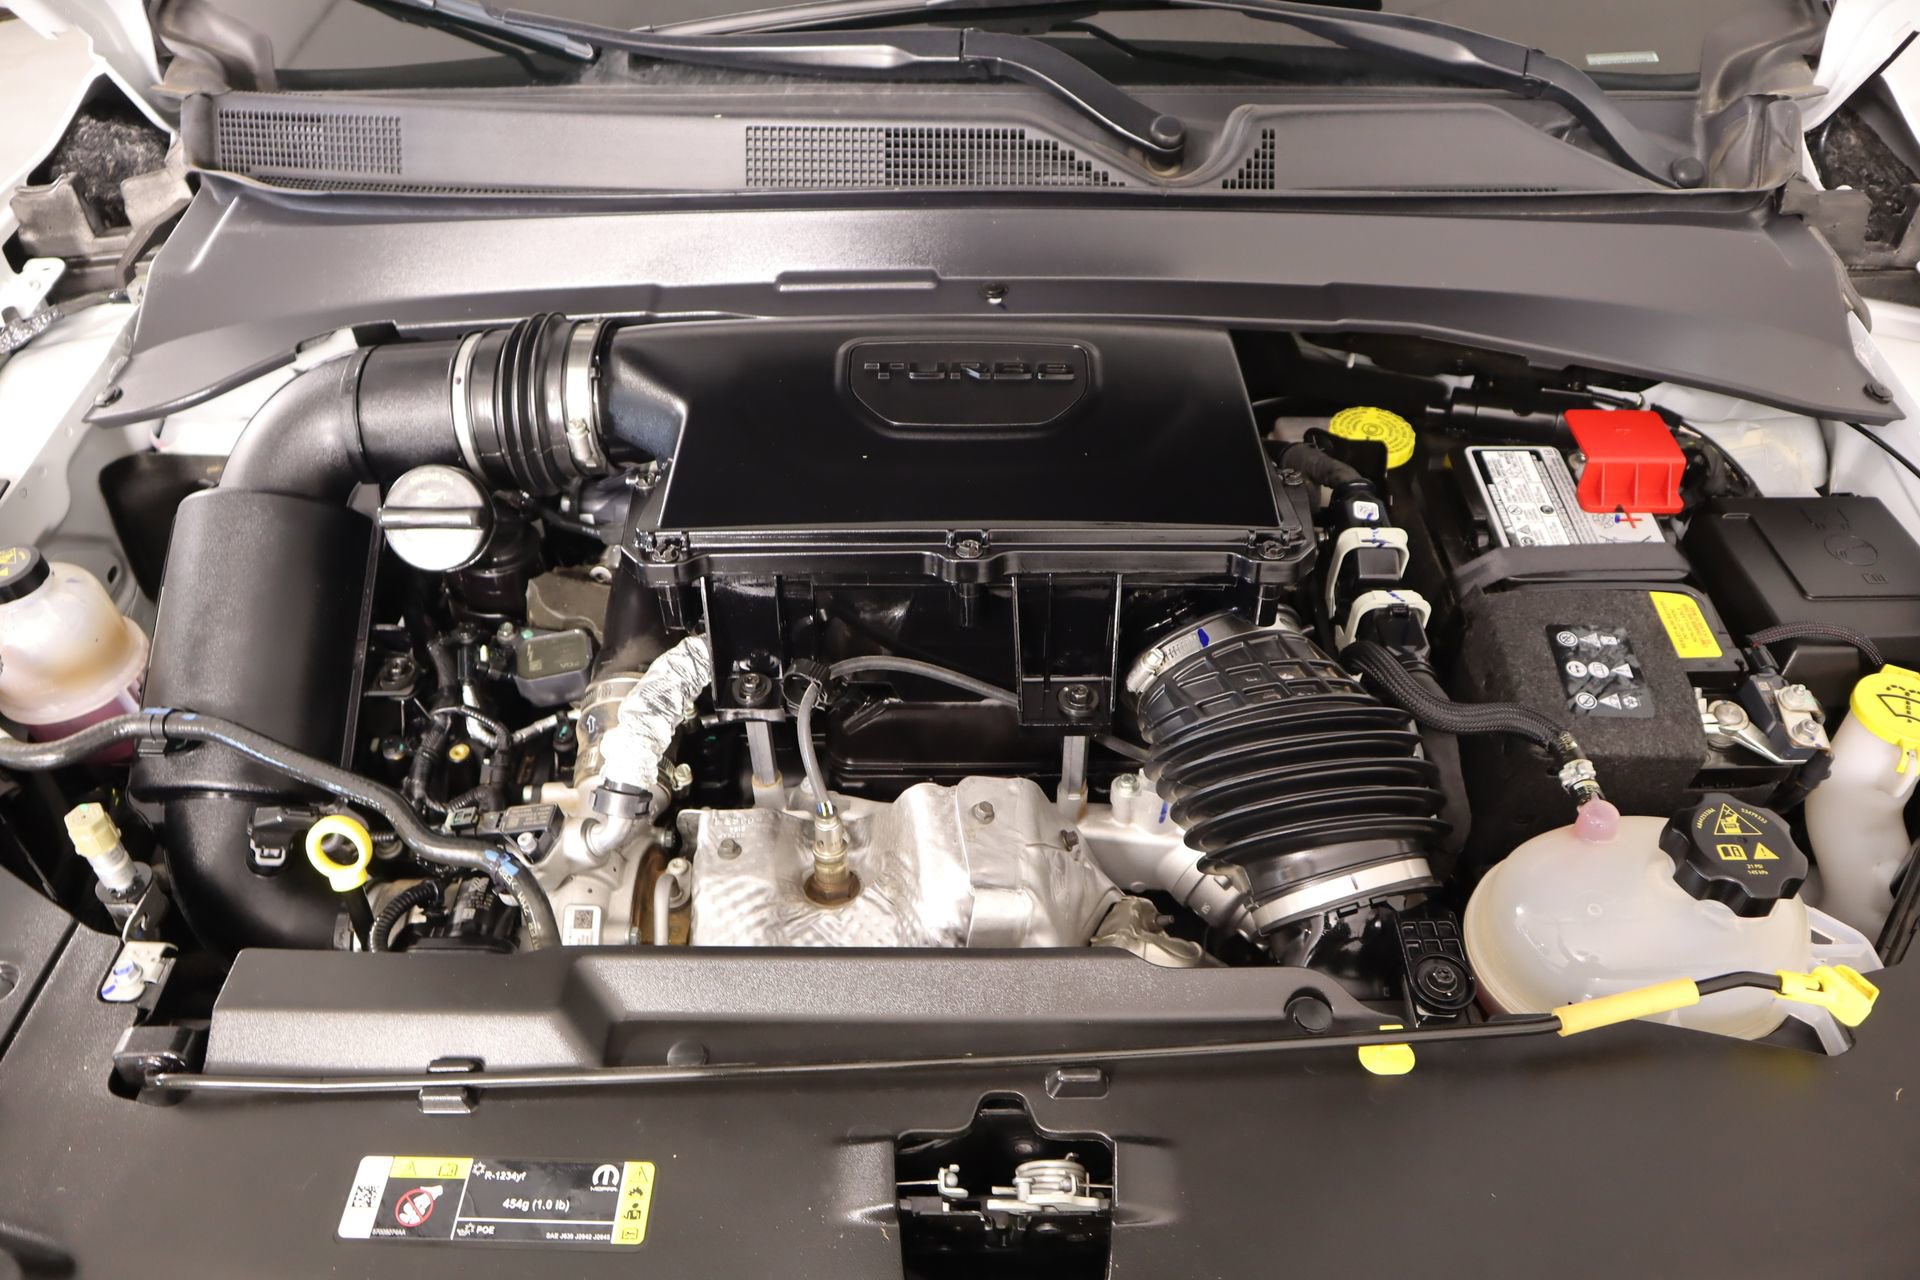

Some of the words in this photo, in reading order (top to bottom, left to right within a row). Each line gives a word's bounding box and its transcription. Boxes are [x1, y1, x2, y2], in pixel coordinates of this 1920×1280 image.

[484, 1170, 527, 1183] R-1234yf
[502, 1198, 529, 1212] 454g
[532, 1199, 553, 1212] (1.0
[555, 1199, 570, 1213] lb)
[475, 1225, 495, 1235] POE
